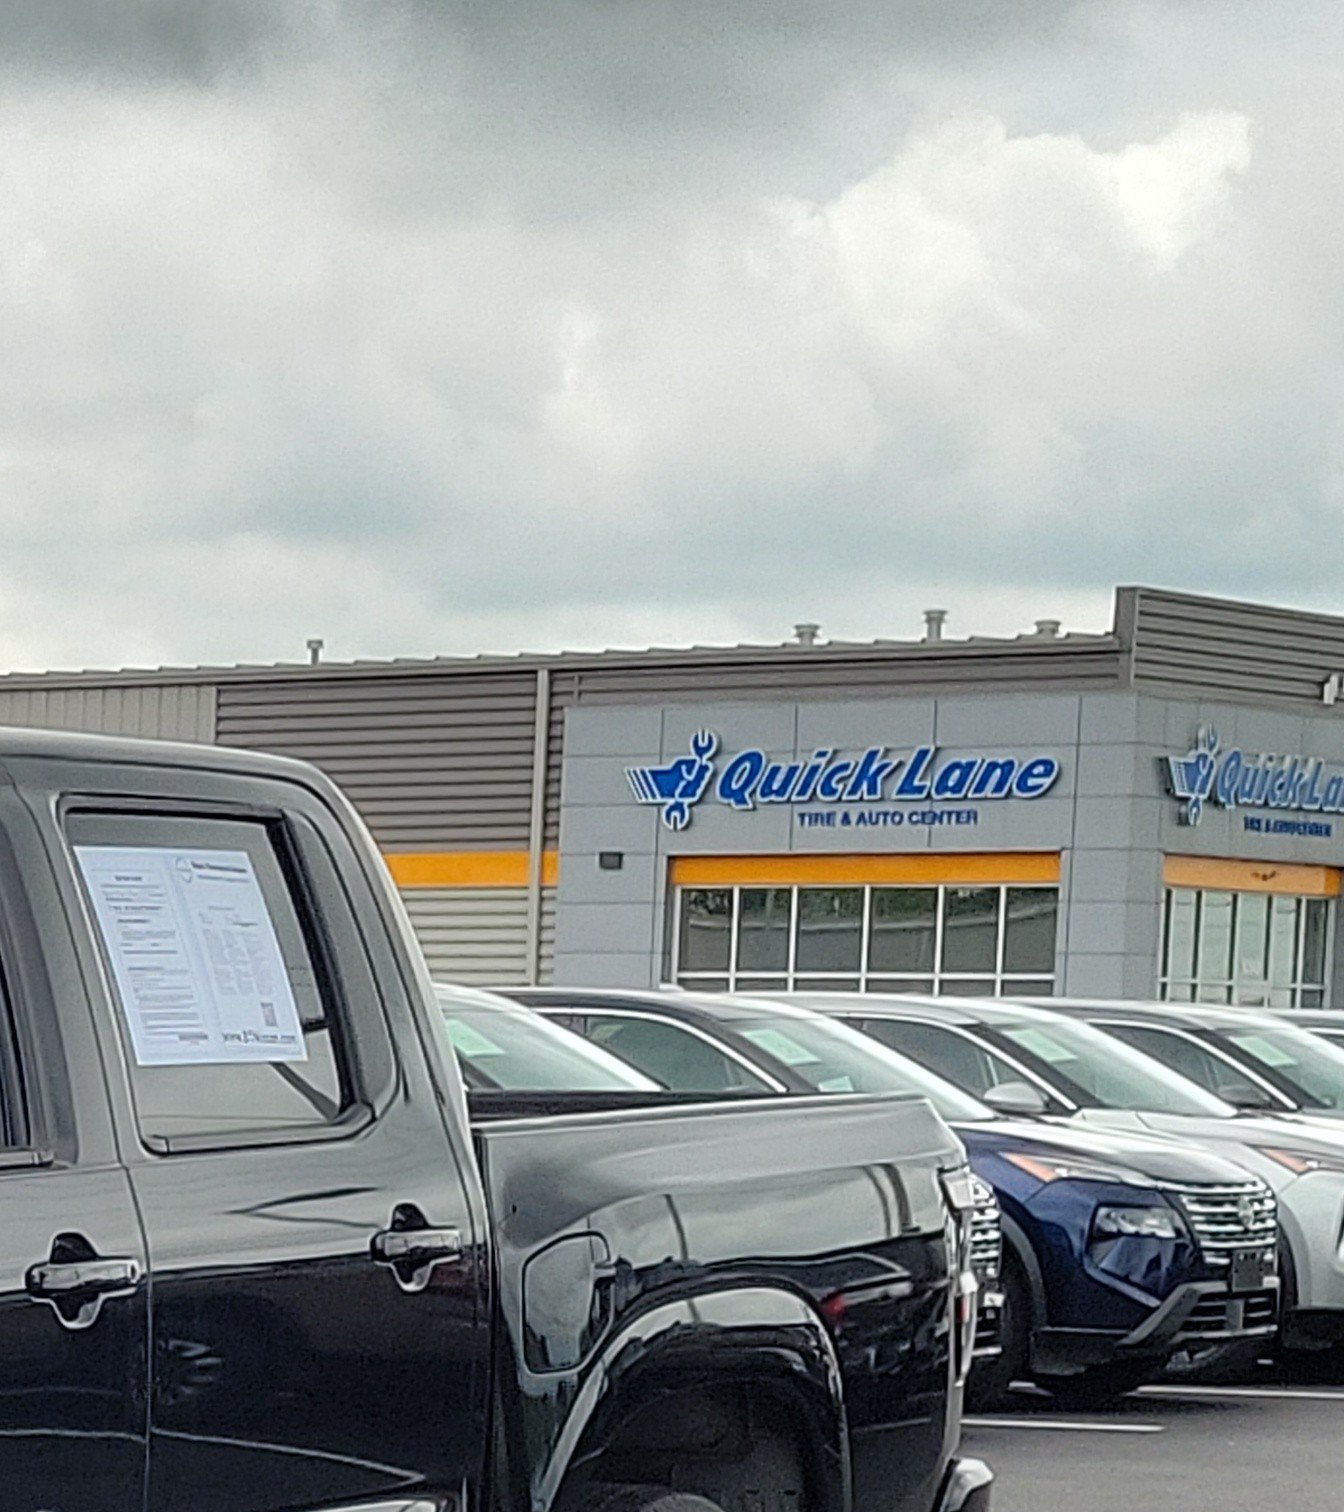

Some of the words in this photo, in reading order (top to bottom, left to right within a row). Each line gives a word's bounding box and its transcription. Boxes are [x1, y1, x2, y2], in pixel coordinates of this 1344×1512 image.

[716, 748, 895, 810] Quick
[895, 746, 1059, 800] Lane
[1217, 747, 1306, 810] Quick
[798, 812, 837, 827] TIRE
[841, 811, 851, 827] &
[855, 811, 904, 827] AUTO
[908, 809, 979, 826] CENTER
